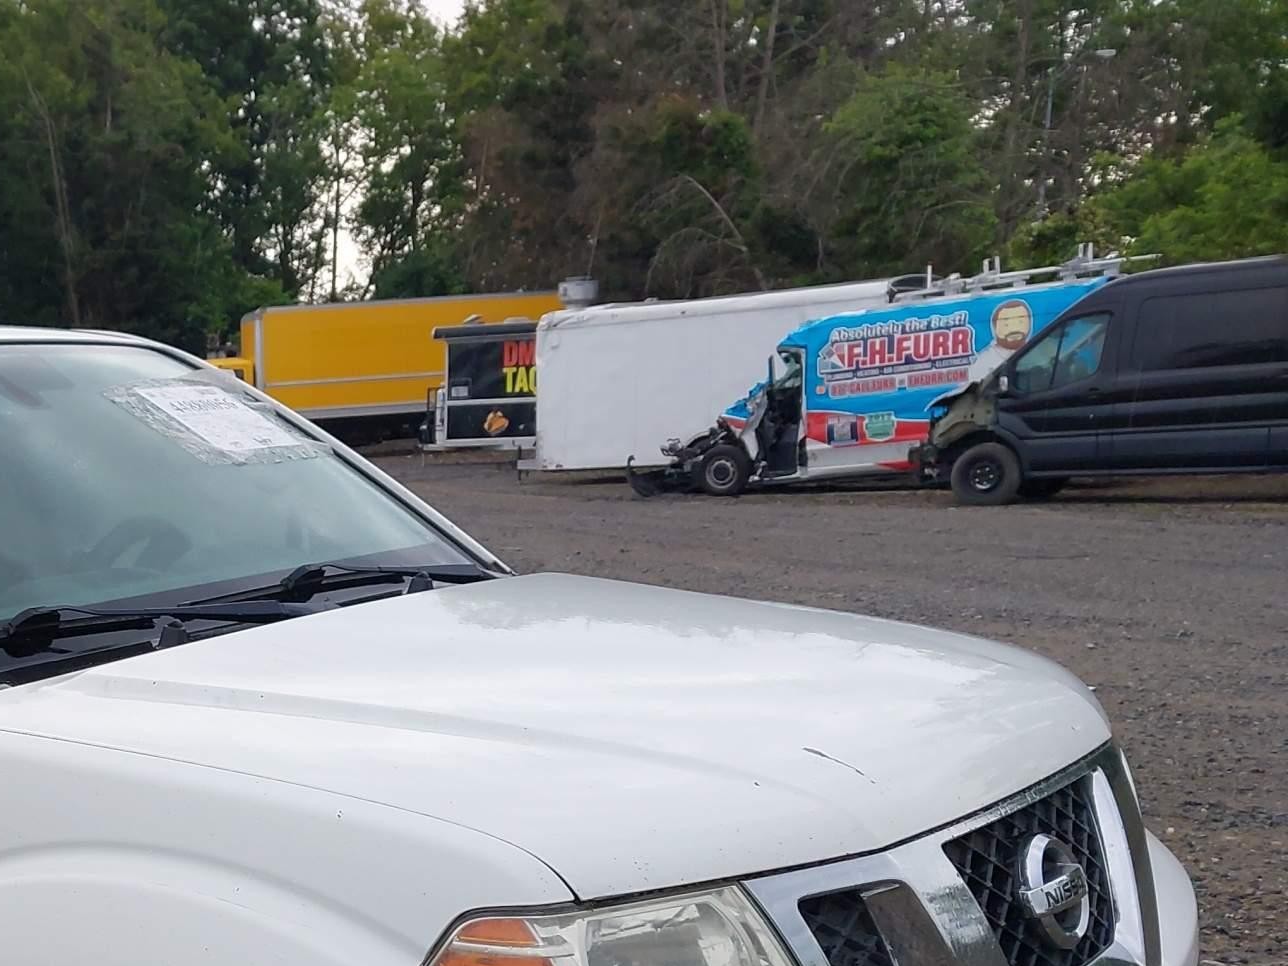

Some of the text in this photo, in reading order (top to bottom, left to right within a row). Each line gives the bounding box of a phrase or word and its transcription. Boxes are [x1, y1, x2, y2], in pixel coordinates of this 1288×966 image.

[832, 313, 966, 341] Absolutely the Best!
[846, 328, 970, 368] F.H.FURR
